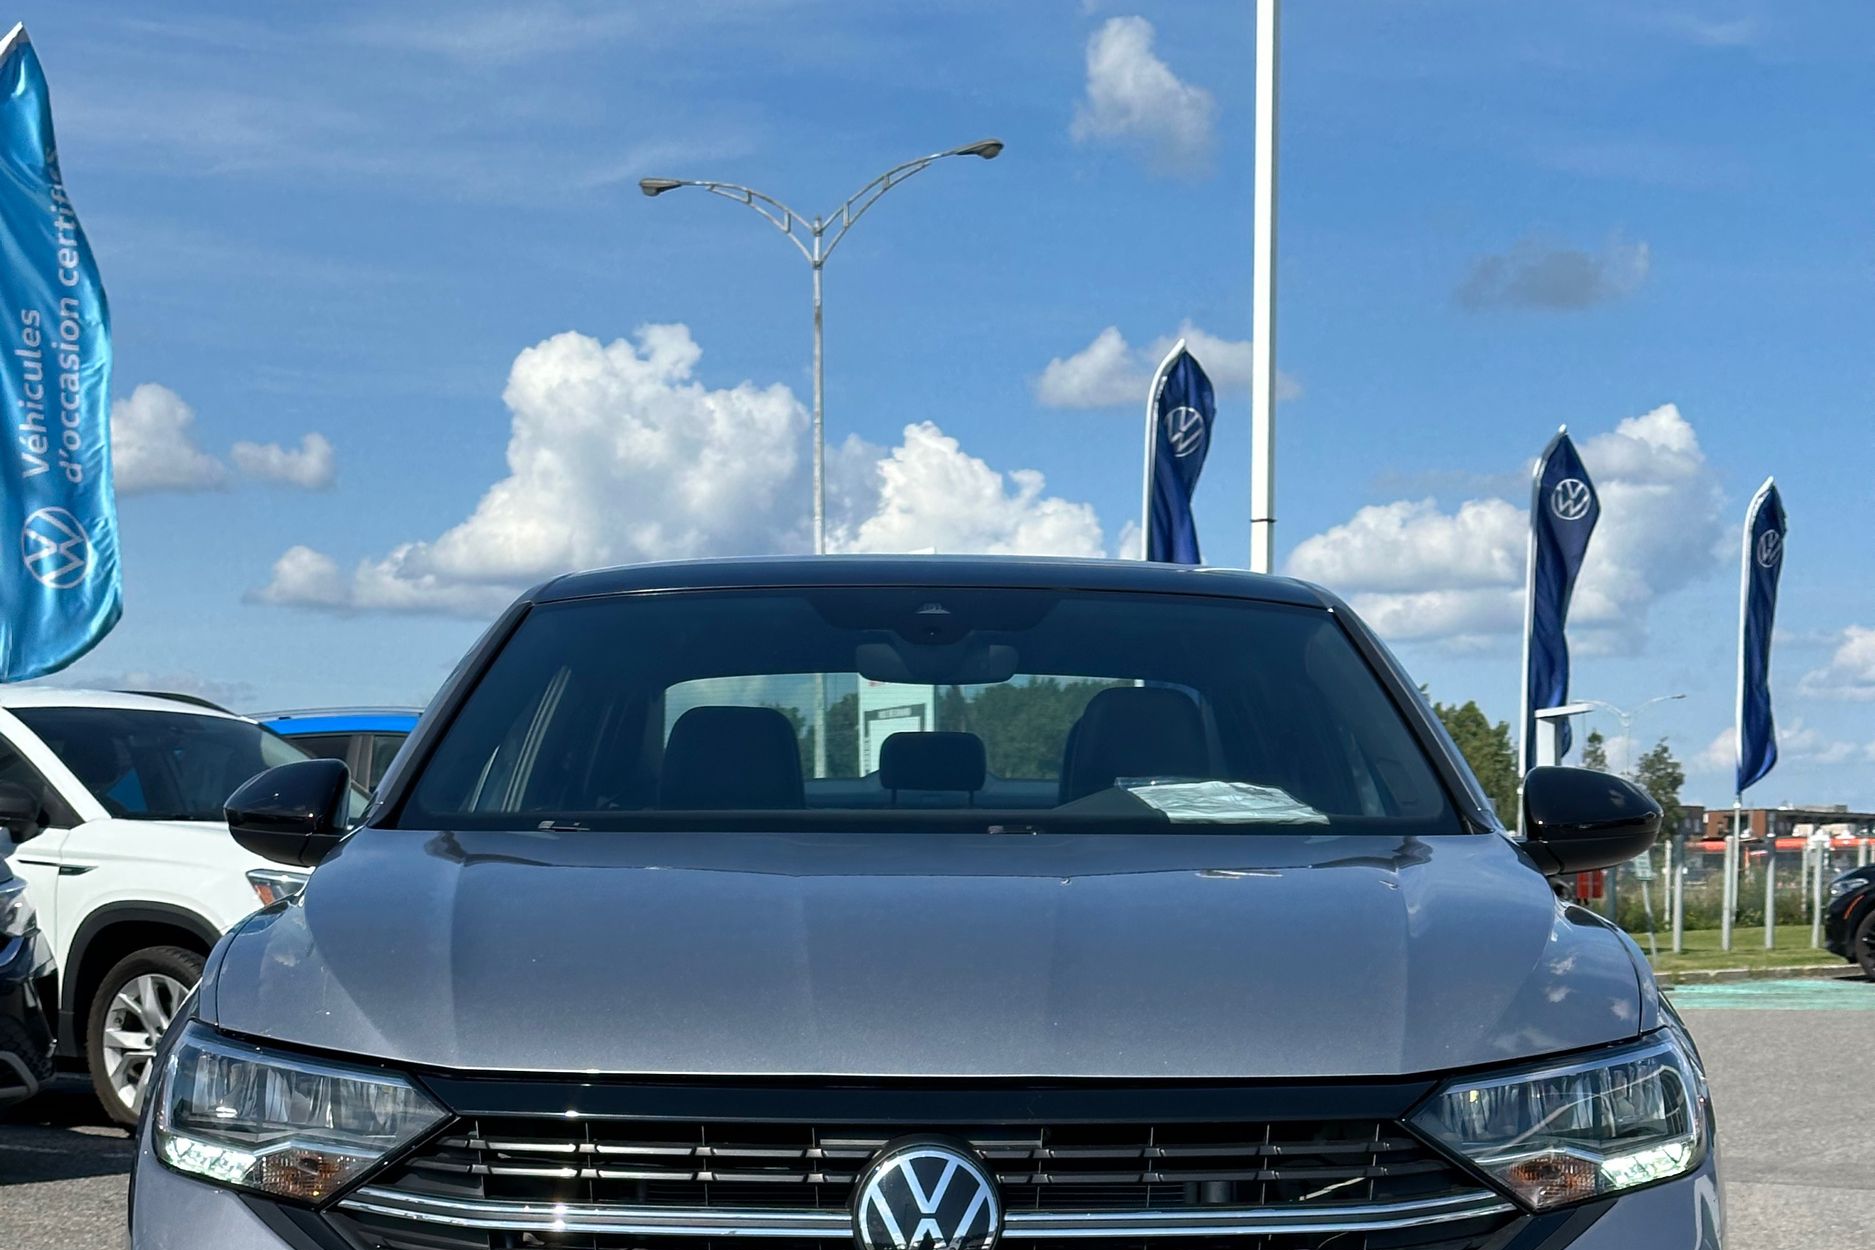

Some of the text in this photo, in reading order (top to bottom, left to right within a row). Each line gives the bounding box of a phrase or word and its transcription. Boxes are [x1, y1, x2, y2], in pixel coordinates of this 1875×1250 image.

[15, 309, 51, 479] Véhicules
[51, 297, 84, 485] d'occasion
[23, 508, 88, 587] VW
[1552, 480, 1590, 519] VW
